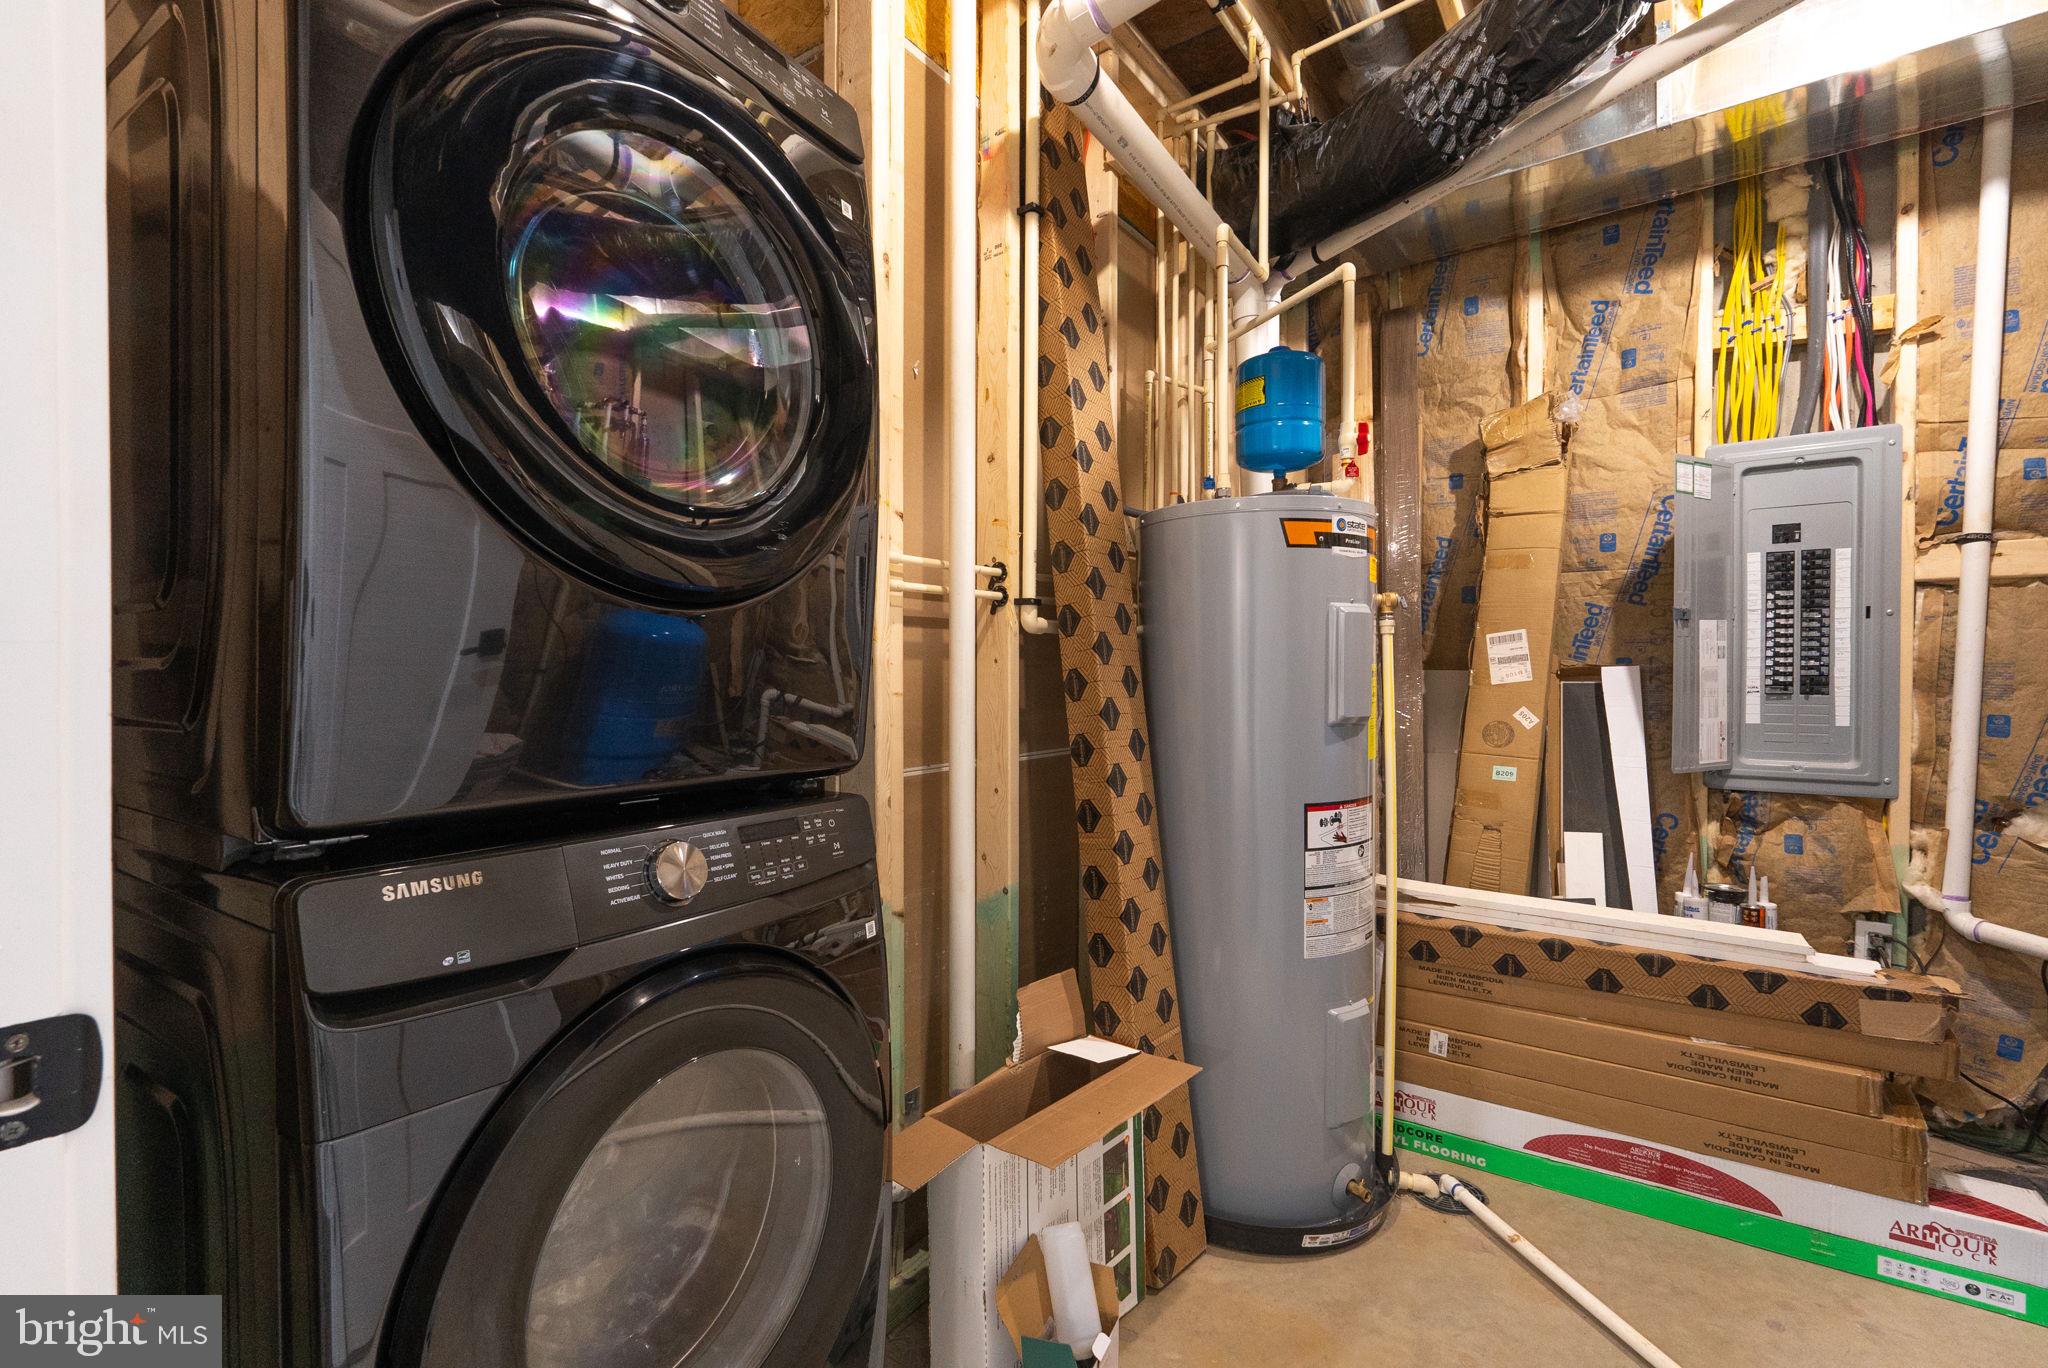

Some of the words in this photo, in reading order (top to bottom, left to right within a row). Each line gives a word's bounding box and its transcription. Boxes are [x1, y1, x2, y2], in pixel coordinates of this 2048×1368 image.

[1634, 198, 1675, 294] rtainTeed
[1417, 255, 1449, 358] CertainTee
[1569, 300, 1610, 395] ertainTeed
[1347, 520, 1366, 531] state
[1568, 602, 1604, 663] inTeed
[709, 842, 730, 850] DELICATES
[603, 861, 620, 870] HEAVY
[382, 871, 483, 902] SAMSUNG
[608, 884, 630, 893] BEDDING
[610, 895, 641, 905] ACTIVEWEAR
[1418, 965, 1443, 974] MADE
[1456, 971, 1504, 984] CAMBODIA
[1436, 974, 1458, 982] NIEN
[1458, 978, 1485, 987] MADE
[1399, 1026, 1421, 1035] MADE
[1448, 1037, 1482, 1049] MBODIA
[1666, 1062, 1727, 1079] CAMBODIA
[1691, 1060, 1723, 1071] MADE
[1728, 1066, 1754, 1077] NIEN
[1746, 1079, 1779, 1090] MADE
[1375, 1090, 1437, 1115] AMOUR
[1401, 1107, 1437, 1121] LOCK
[1414, 1140, 1487, 1167] FLOORING
[1704, 1142, 1766, 1161] CAMBODIA
[1729, 1141, 1762, 1153] MADE
[1766, 1149, 1794, 1161] NIEN
[1683, 1168, 1713, 1179] Protection
[1785, 1161, 1820, 1174] MADE
[1890, 1220, 1998, 1258] ARMOUR
[1938, 1244, 1997, 1266] LOCK
